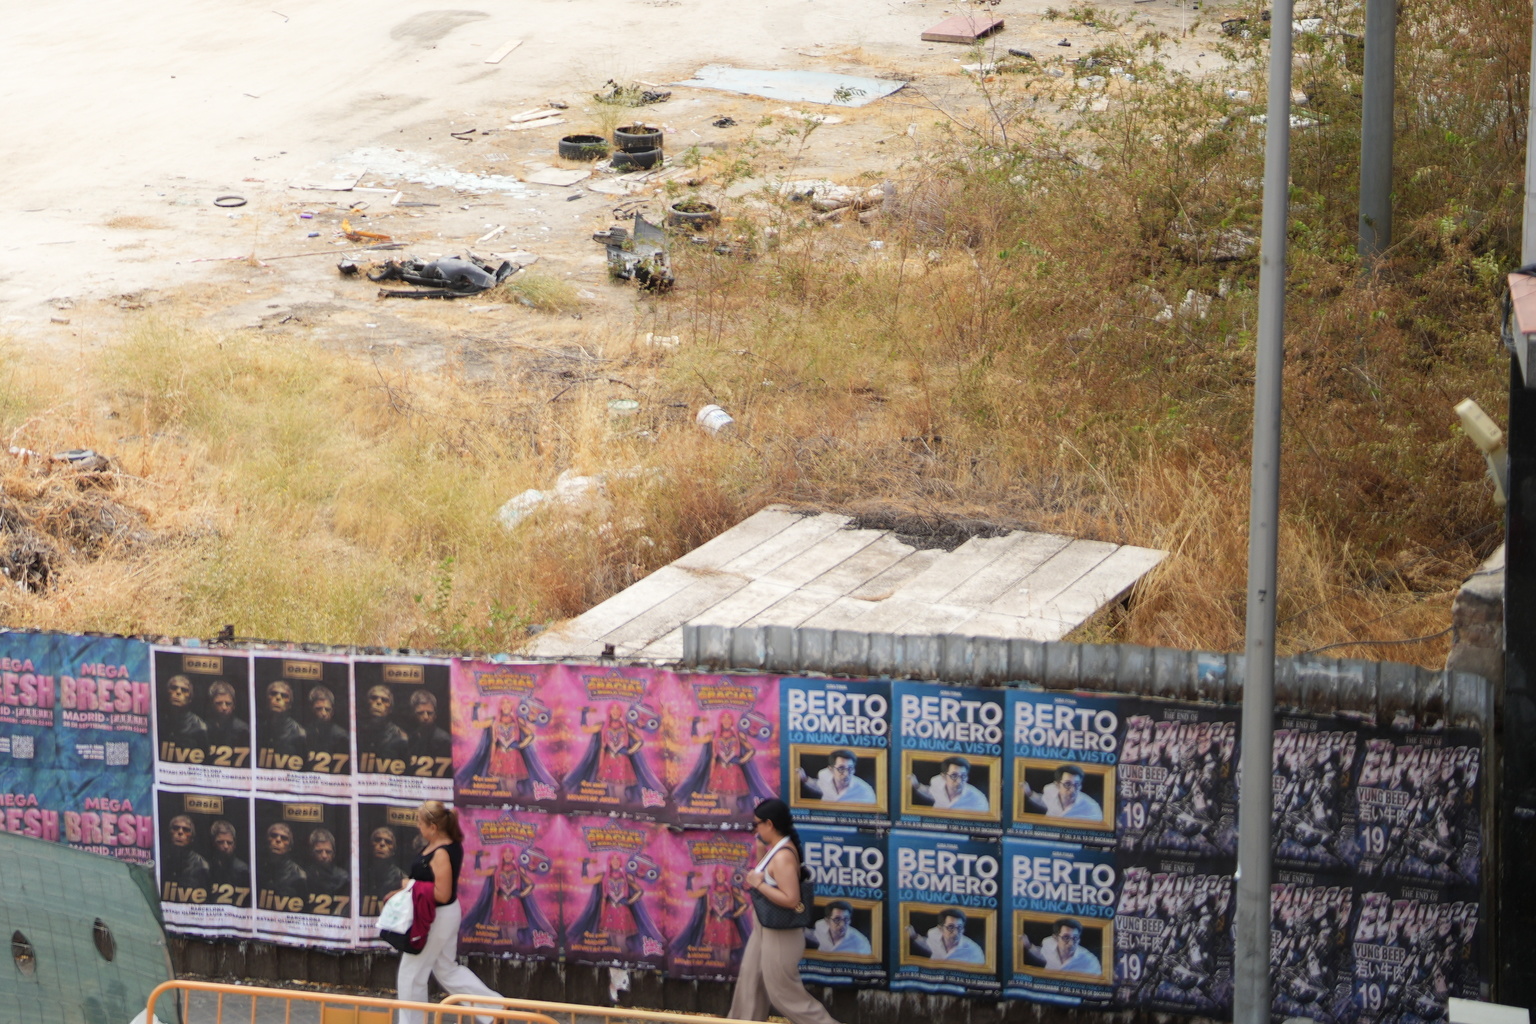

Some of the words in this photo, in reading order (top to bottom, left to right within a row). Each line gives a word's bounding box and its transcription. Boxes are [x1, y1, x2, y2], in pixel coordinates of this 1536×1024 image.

[81, 662, 129, 679] MEGA
[187, 658, 219, 670] oasis
[287, 664, 320, 676] oasis
[387, 668, 420, 680] oasis
[478, 677, 535, 689] GRACIAS
[61, 675, 150, 715] BRESH
[587, 681, 644, 694] GRACIAS
[697, 690, 756, 702] GRACIAS
[787, 688, 888, 719] BERTO
[901, 694, 1003, 727] BERTO
[62, 710, 105, 723] MADRID
[788, 712, 888, 737] ROMERO
[1014, 701, 1118, 735] BERTO
[1164, 711, 1175, 720] THE
[1177, 711, 1190, 721] END
[1190, 712, 1198, 721] OF
[1282, 719, 1294, 727] THE
[1295, 719, 1308, 728] END
[1309, 720, 1318, 729] OF
[788, 732, 803, 743] LO
[805, 733, 848, 746] NUNCA
[849, 735, 887, 748] VISTO
[901, 717, 1002, 744] ROMERO
[1014, 726, 1117, 753] ROMERO
[901, 737, 916, 749] LO
[919, 738, 962, 752] NUNCA
[964, 742, 1002, 756] VISTO
[1405, 736, 1418, 744] THE
[1419, 737, 1432, 745] END
[160, 741, 205, 764] live
[259, 747, 304, 771] live
[1014, 745, 1030, 757] LO
[1032, 746, 1075, 760] NUNCA
[1077, 751, 1117, 765] VISTO
[359, 752, 407, 775] live
[1119, 764, 1144, 780] YUNG
[1145, 766, 1167, 781] BEEF
[84, 797, 133, 812] MEGA
[188, 798, 220, 810] oasis
[1358, 787, 1384, 804] YUNG
[1385, 790, 1409, 806] BEEF
[287, 806, 320, 818] oasis
[1123, 802, 1144, 829] 19
[65, 811, 153, 853] BRESH
[480, 826, 534, 838] GRACIAS
[587, 832, 643, 845] GRACIAS
[1362, 825, 1384, 854] 19
[691, 846, 749, 859] GRACIAS
[804, 841, 884, 872] ERTO
[897, 847, 999, 880] BERTO
[1012, 854, 1116, 889] BERTO
[1160, 862, 1172, 871] THE
[1173, 863, 1185, 872] END
[1186, 864, 1195, 873] OF
[805, 866, 883, 889] OMERO
[898, 871, 998, 898] ROMERO
[164, 881, 208, 904] live
[259, 889, 304, 913] live
[813, 885, 845, 898] UNCA
[846, 887, 883, 900] VISTO
[898, 889, 914, 900] LO
[916, 890, 960, 904] NUNCA
[961, 893, 998, 908] VISTO
[1013, 879, 1115, 906] ROMERO
[1401, 889, 1413, 898] THE
[1415, 890, 1428, 899] END
[1430, 891, 1439, 901] OF
[1013, 898, 1028, 910] LO
[1031, 899, 1074, 915] NUNCA
[1076, 903, 1114, 918] VISTO
[1116, 916, 1140, 931] YUNG
[1141, 917, 1163, 933] BEEF
[1354, 942, 1380, 959] YUNG
[1381, 945, 1405, 962] BEEF
[1120, 953, 1141, 980] 19
[1358, 982, 1382, 1011] 19
